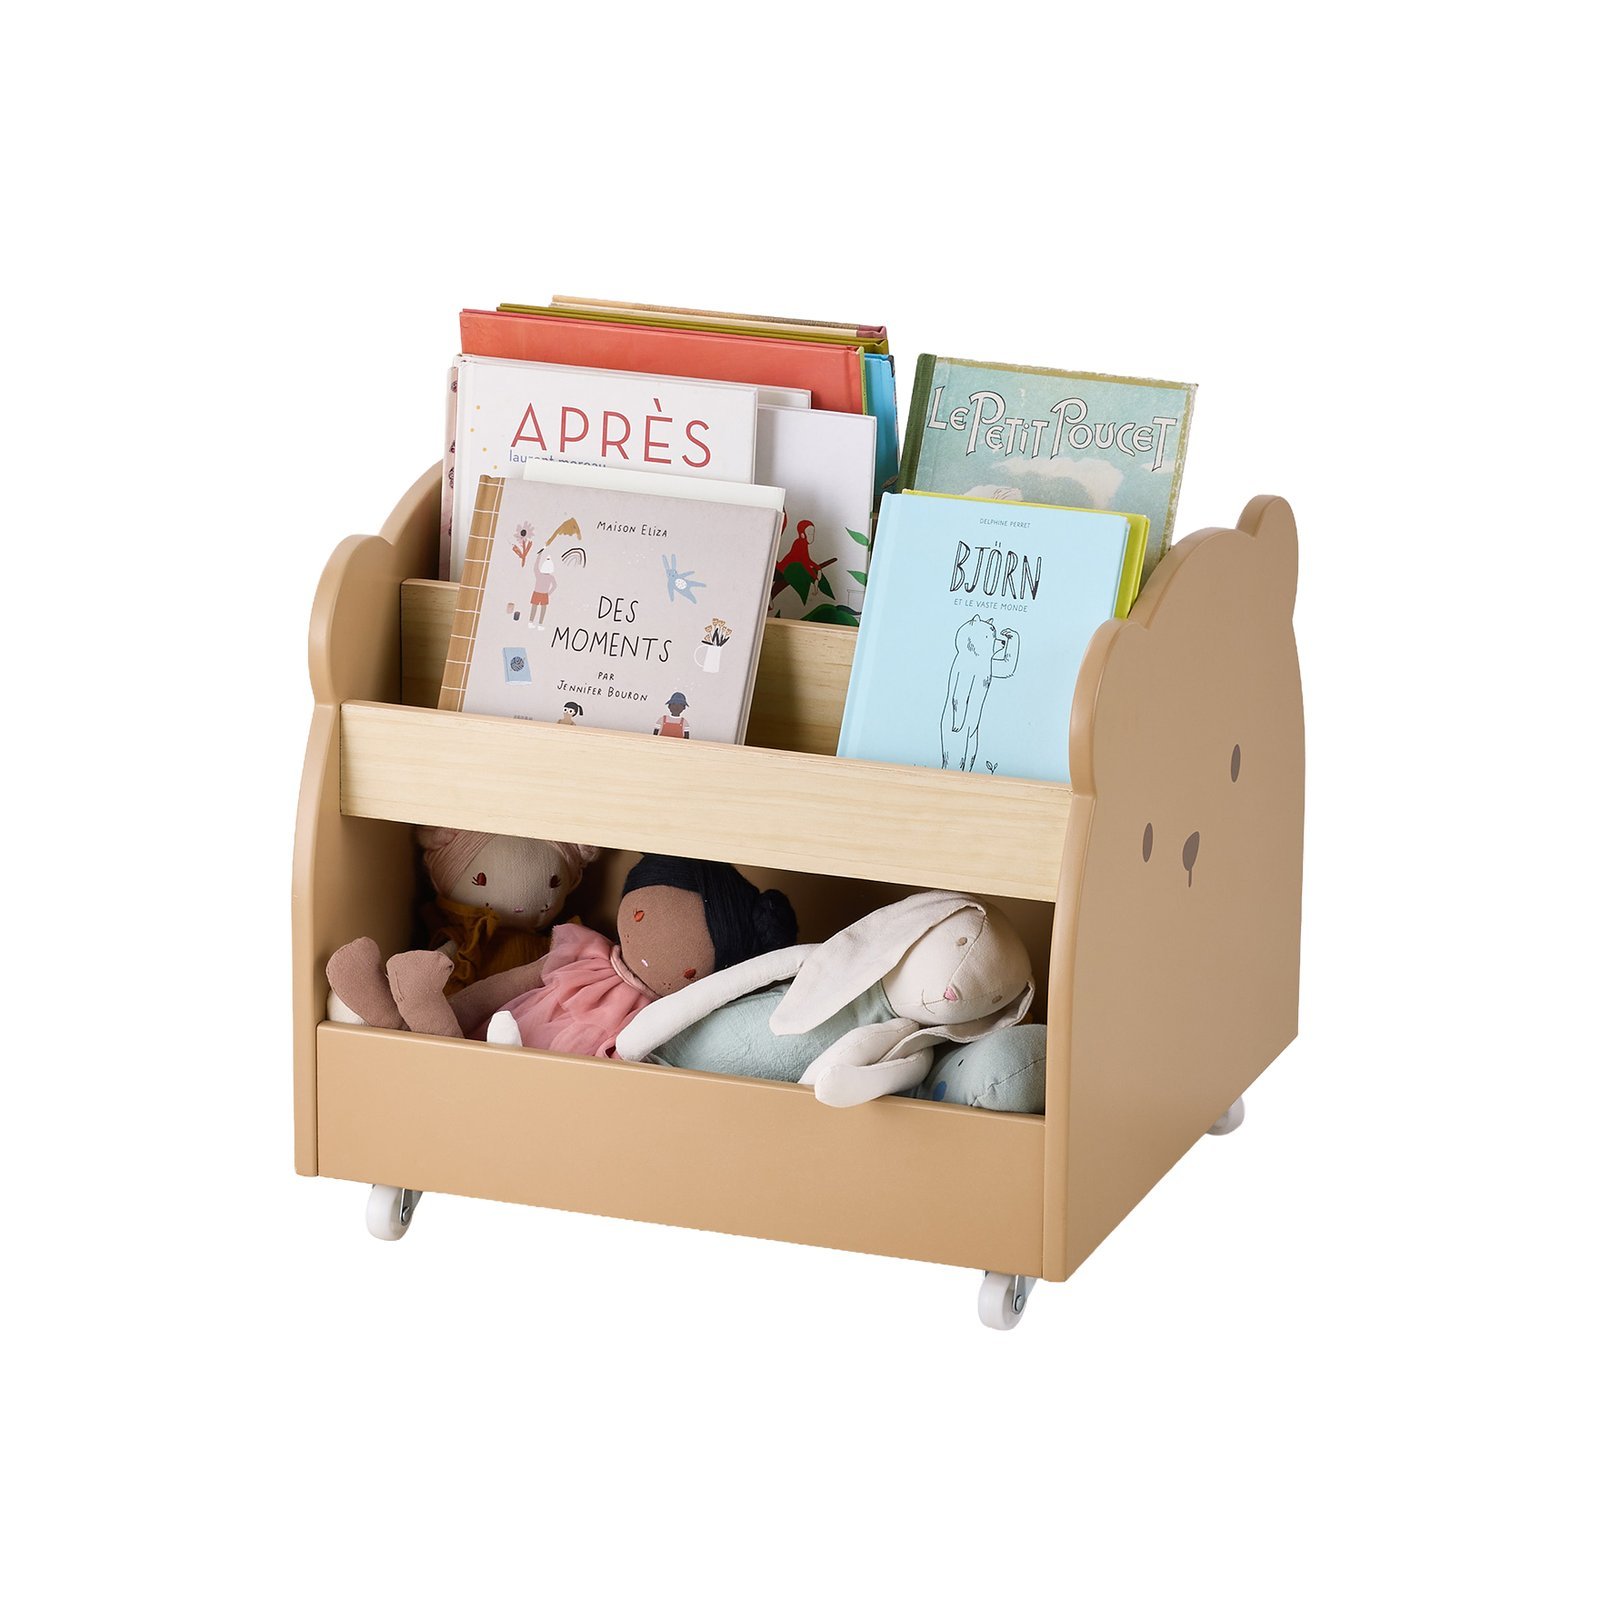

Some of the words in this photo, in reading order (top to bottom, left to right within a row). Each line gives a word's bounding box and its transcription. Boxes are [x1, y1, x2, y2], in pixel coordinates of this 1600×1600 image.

[510, 397, 711, 468] APRÈS
[980, 518, 1008, 527] DELPHINE
[1010, 520, 1031, 529] PERRET
[950, 540, 1042, 600] BJÖRN
[598, 595, 639, 623] DES
[954, 598, 963, 606] ET
[965, 599, 974, 607] LE
[976, 601, 998, 610] VASTE
[1000, 603, 1028, 613] MONDE
[551, 627, 673, 662] MOMENTS
[597, 671, 616, 681] PAR
[607, 686, 648, 701] BOURON
